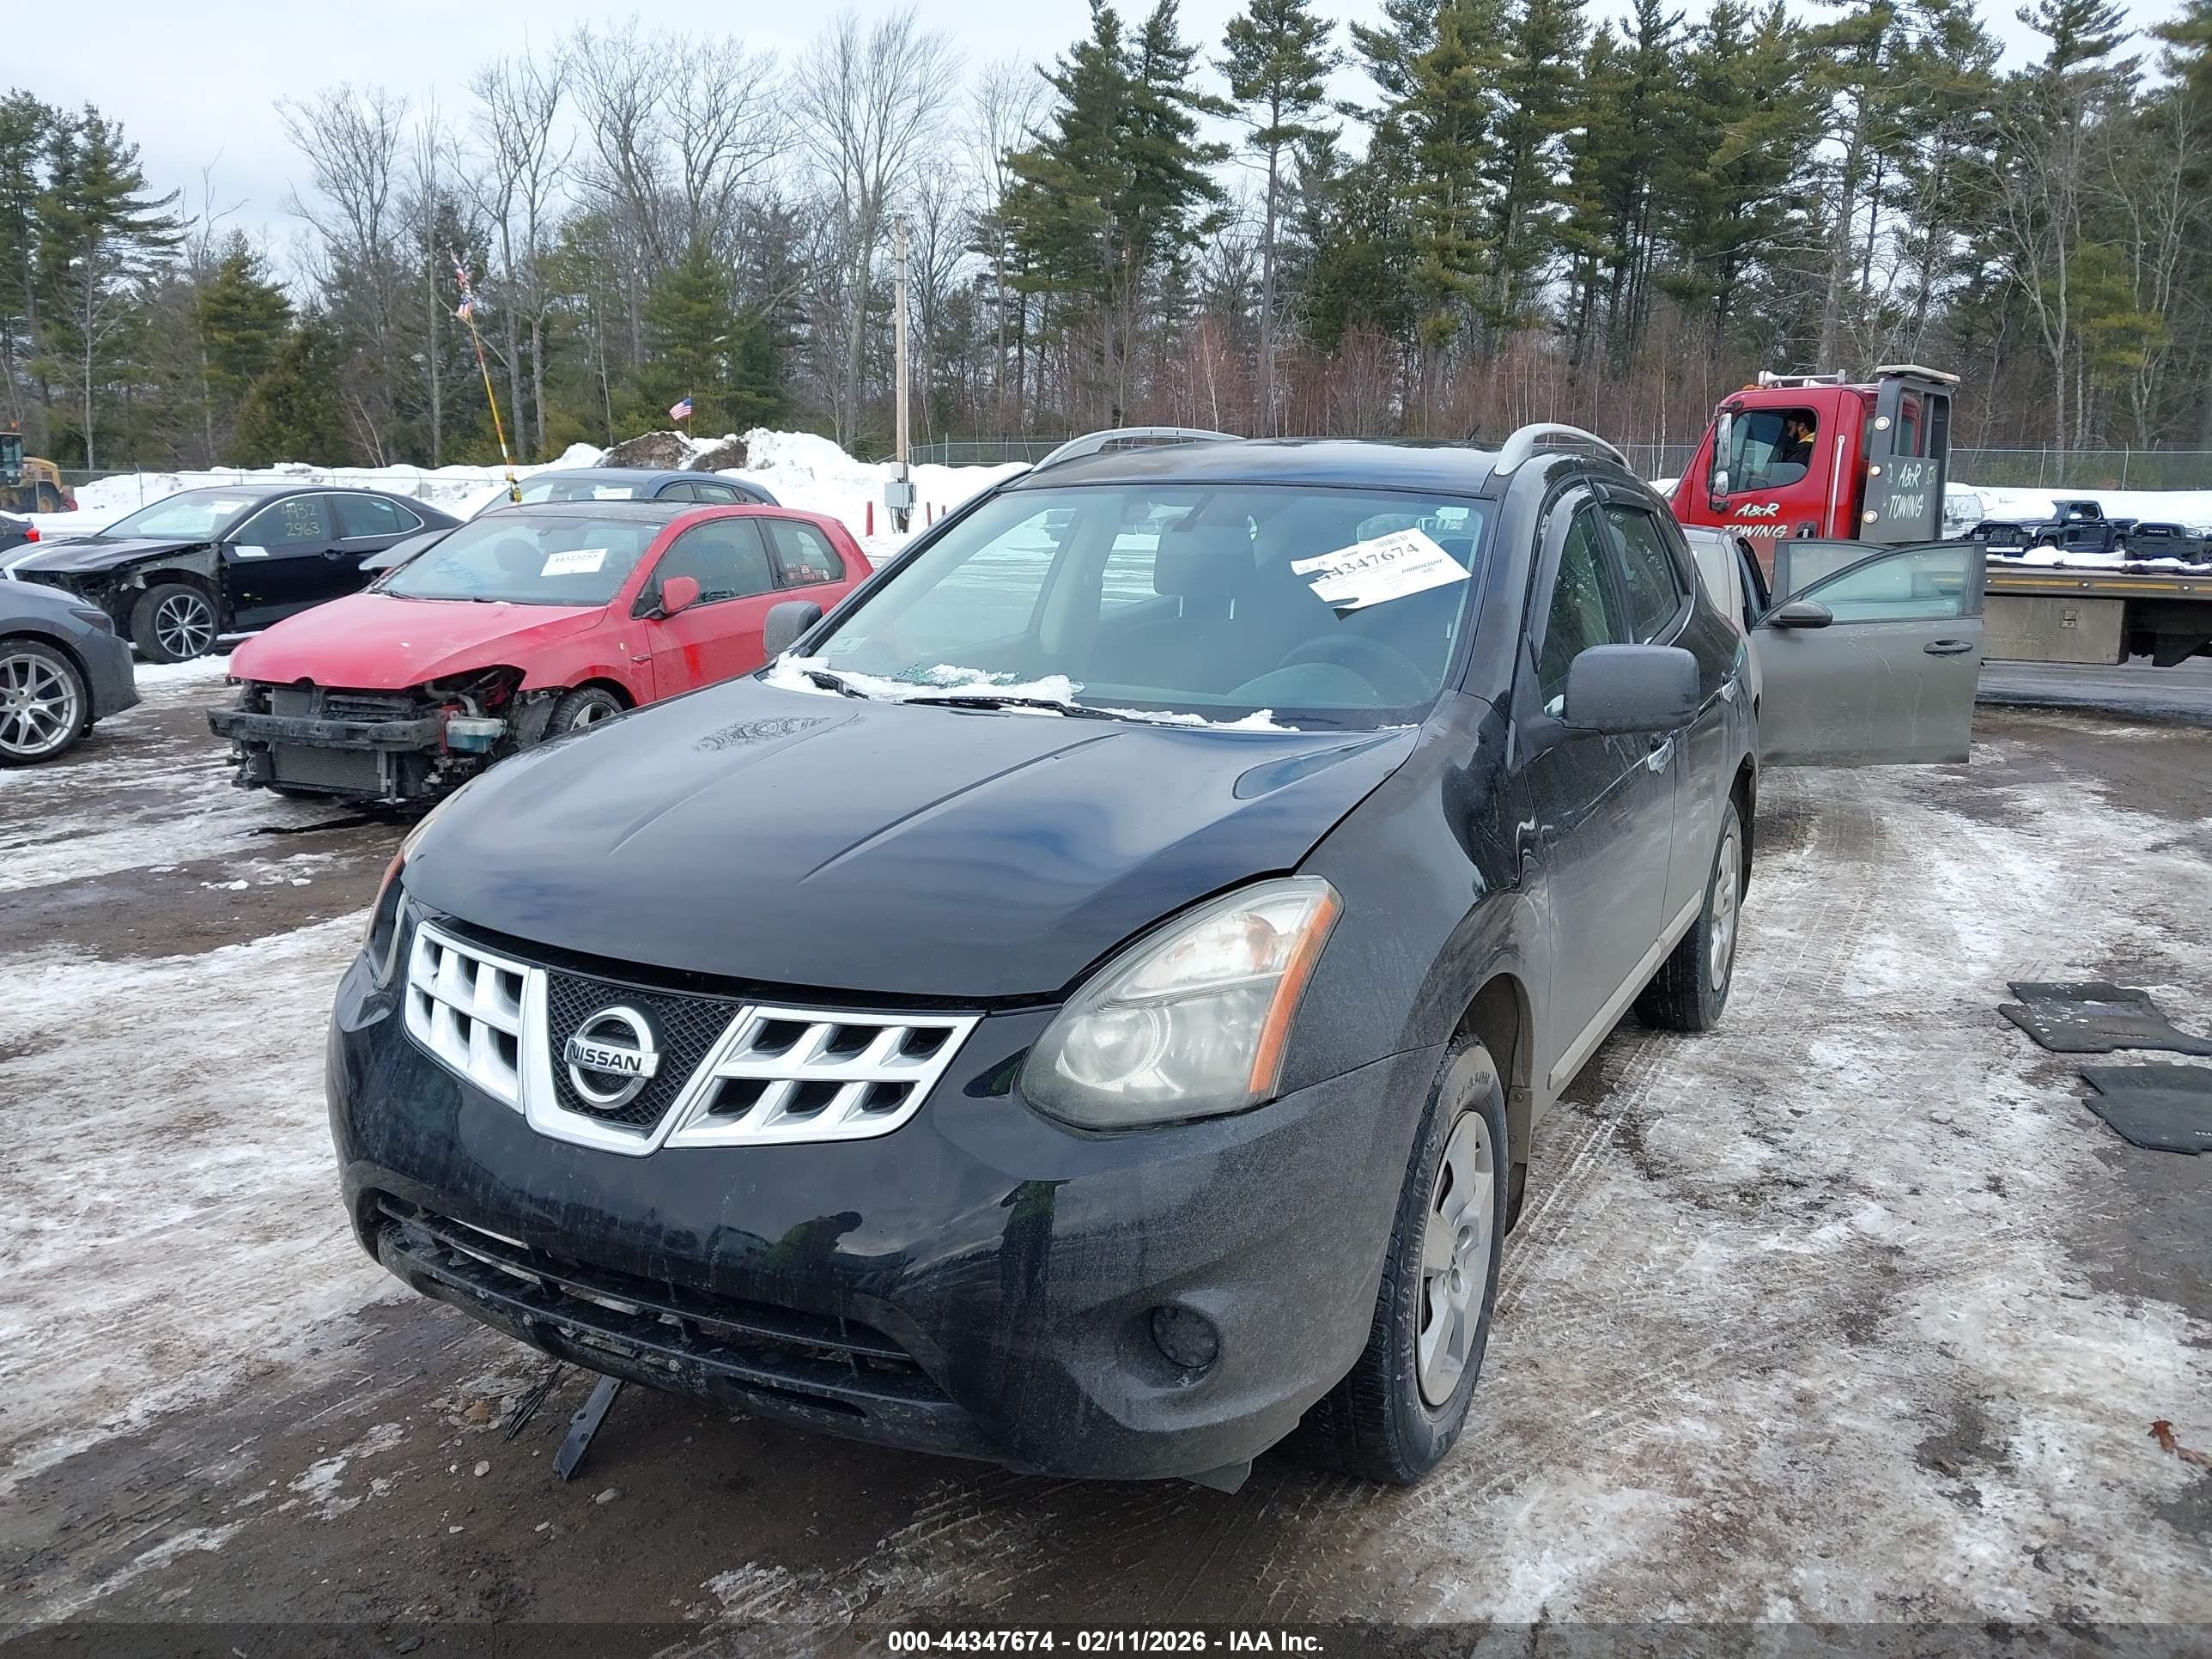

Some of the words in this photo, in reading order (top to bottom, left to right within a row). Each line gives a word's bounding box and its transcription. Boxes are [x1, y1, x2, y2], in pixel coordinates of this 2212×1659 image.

[1897, 463, 1923, 488] A&R
[1735, 502, 1780, 517] A&R
[1889, 494, 1924, 519] TOWING
[285, 521, 320, 537] 2963
[568, 1043, 642, 1072] NISSAN
